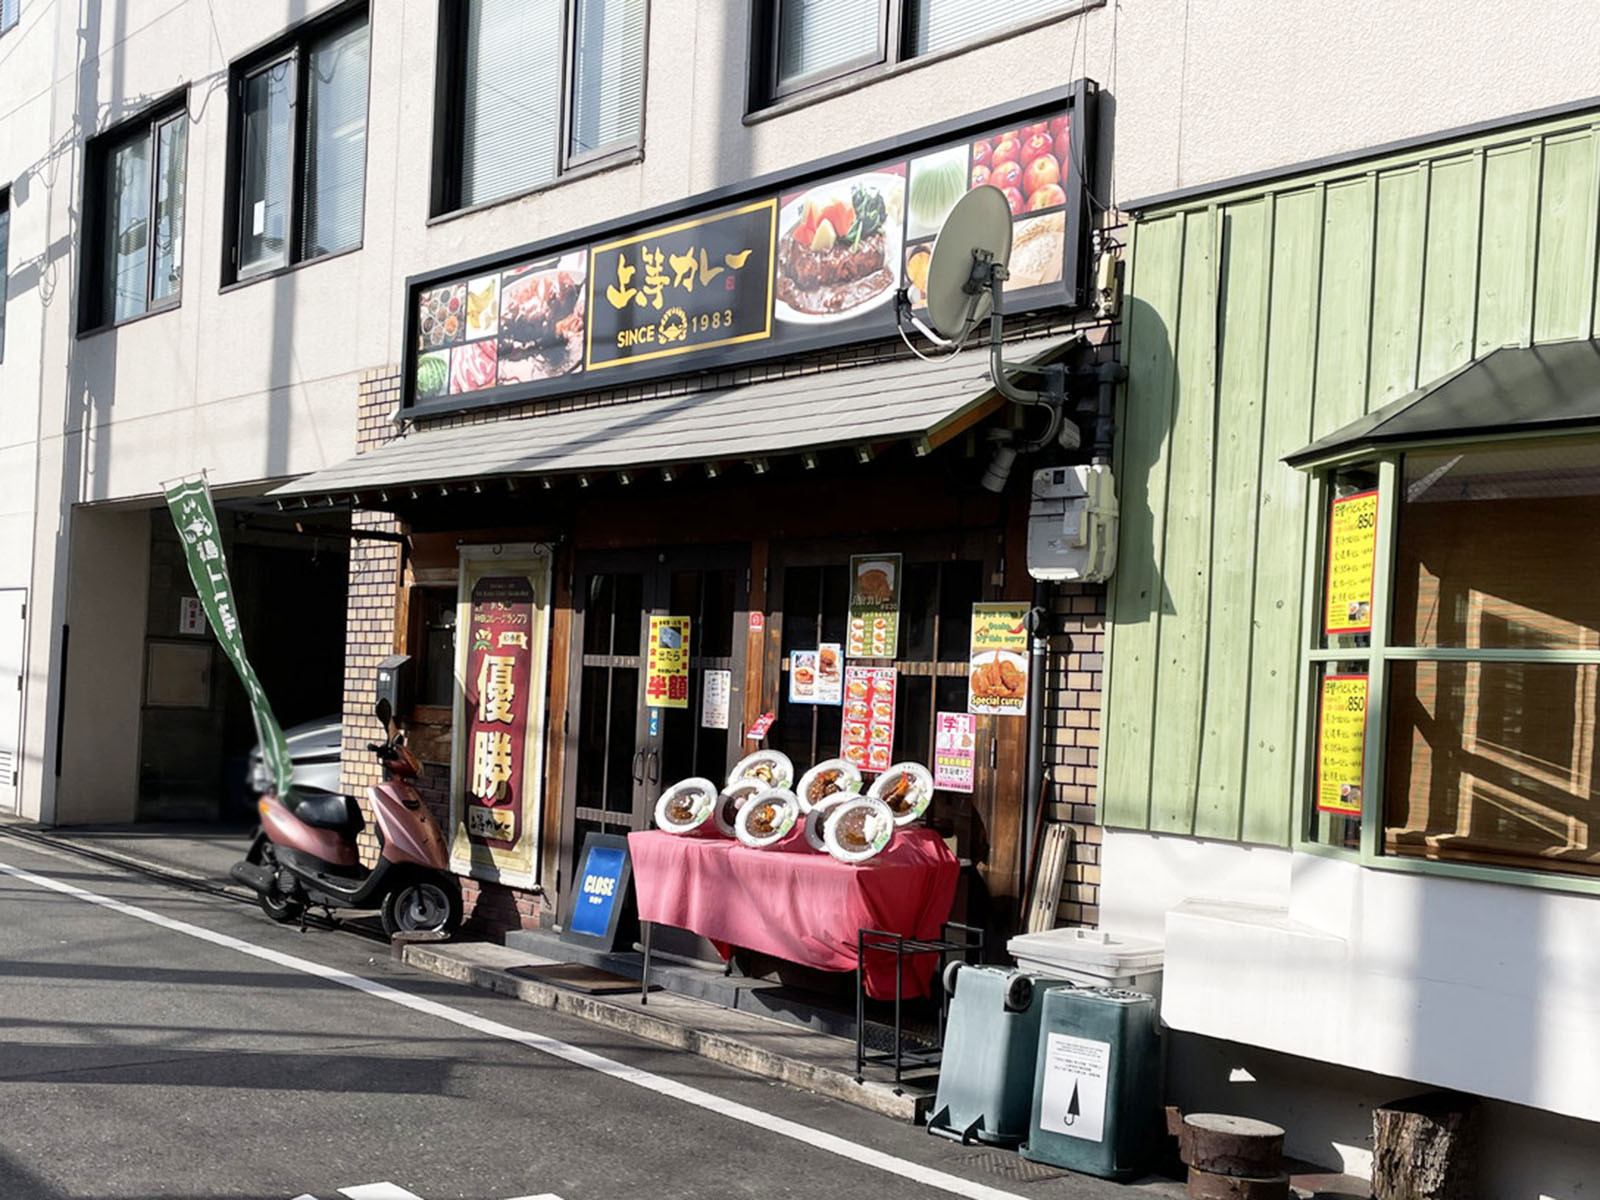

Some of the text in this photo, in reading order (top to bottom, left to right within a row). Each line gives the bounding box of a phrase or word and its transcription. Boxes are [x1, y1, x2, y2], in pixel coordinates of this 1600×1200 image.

[606, 244, 753, 310] 上等カレー
[617, 324, 655, 348] SINCE
[691, 309, 732, 333] 1983
[647, 674, 687, 700] 半額
[971, 693, 1024, 709] Special curry
[470, 653, 513, 800] 優勝
[583, 874, 616, 897] CLOSE
